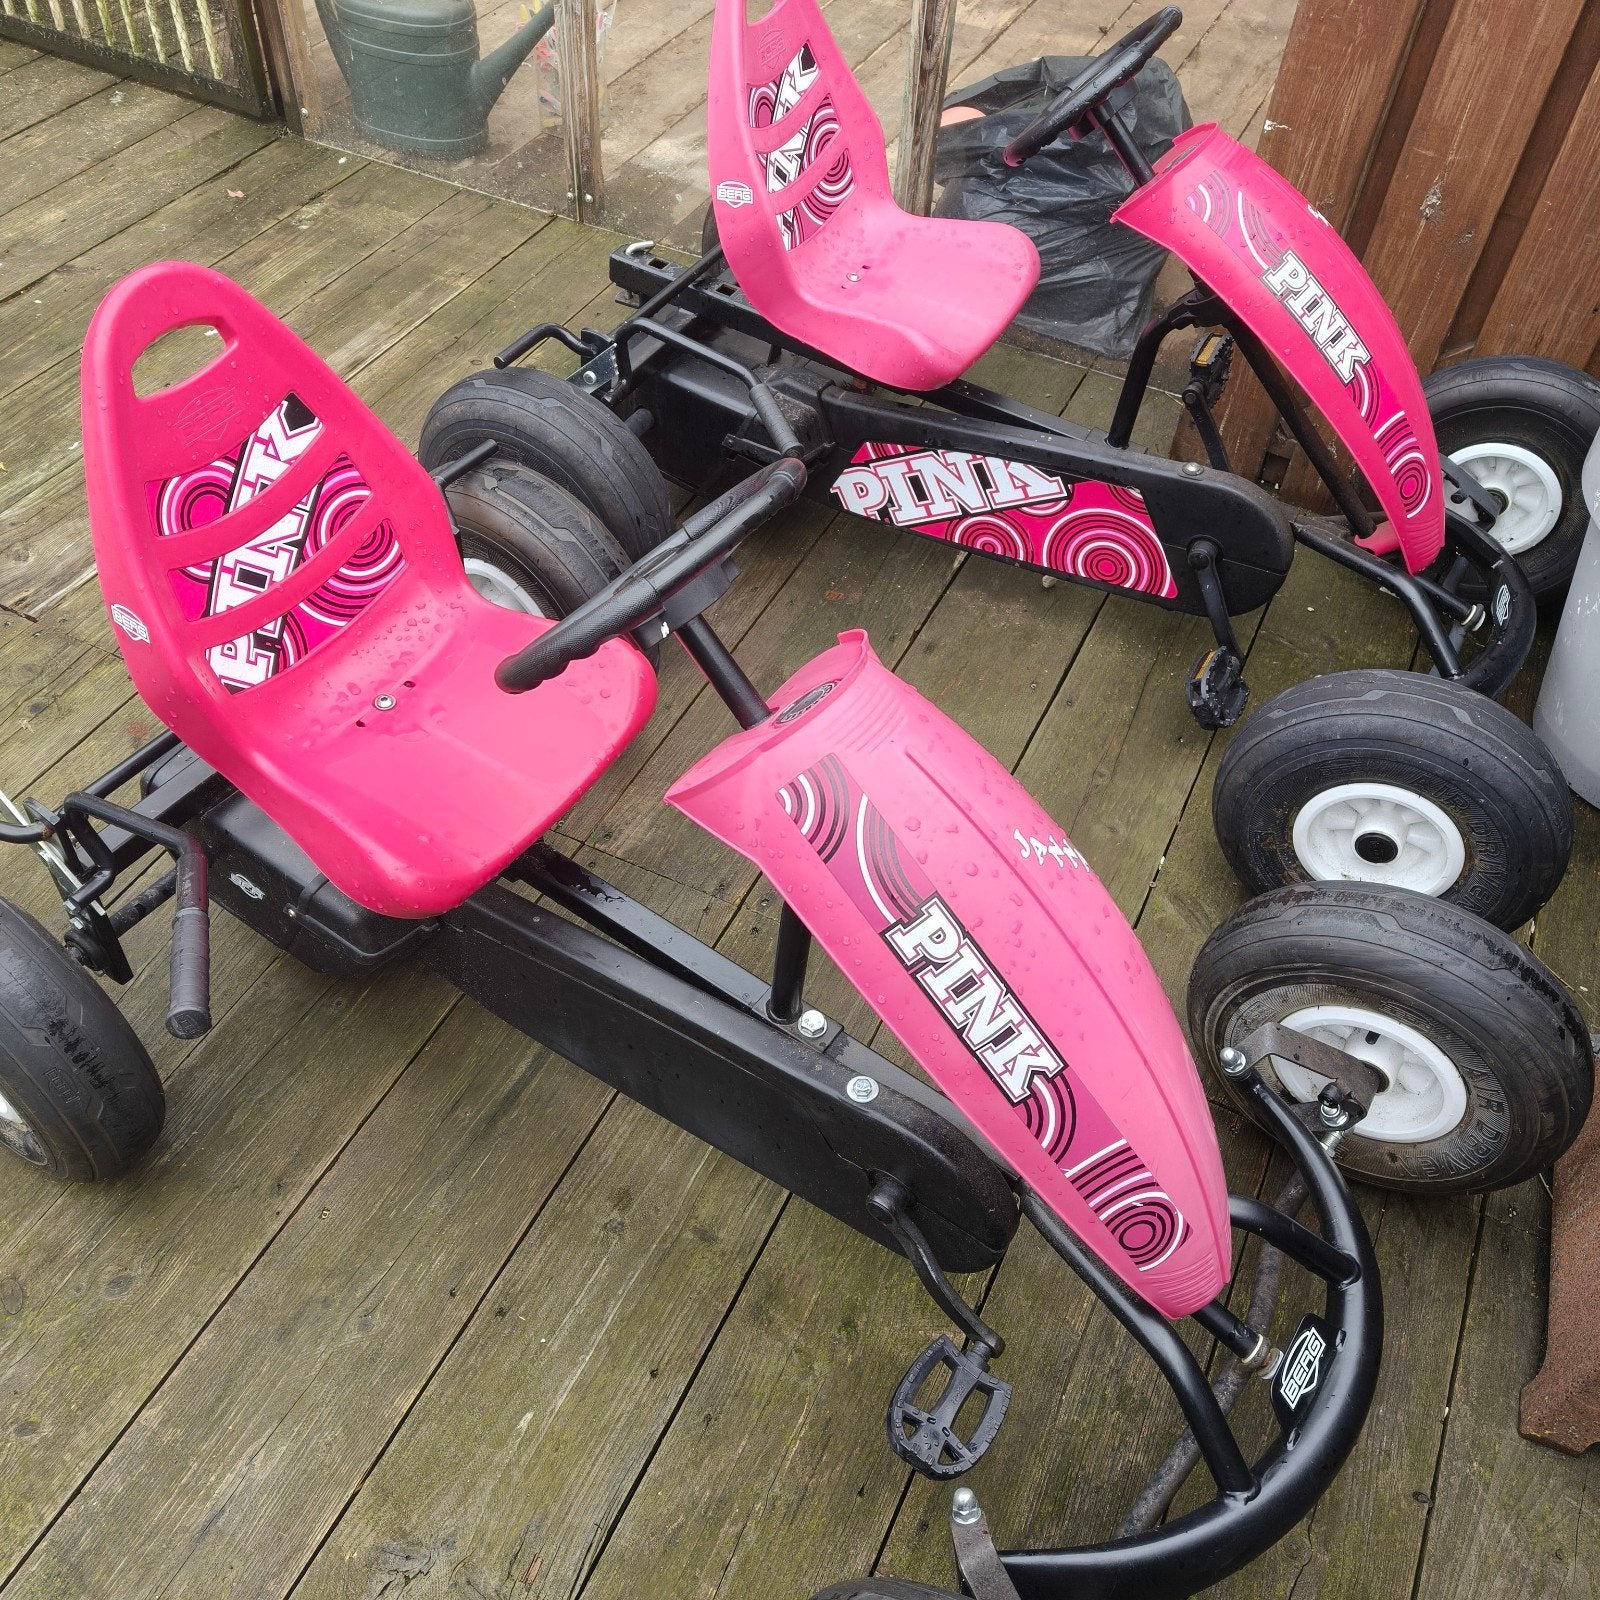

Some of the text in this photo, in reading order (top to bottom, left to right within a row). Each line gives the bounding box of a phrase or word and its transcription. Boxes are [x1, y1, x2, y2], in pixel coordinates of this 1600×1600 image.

[717, 186, 752, 202] BERG
[1261, 249, 1371, 385] PINK
[830, 450, 1068, 526] PINK
[883, 896, 1067, 1105] PINK
[1461, 1064, 1504, 1115] AIR
[1282, 1331, 1323, 1406] BERG
